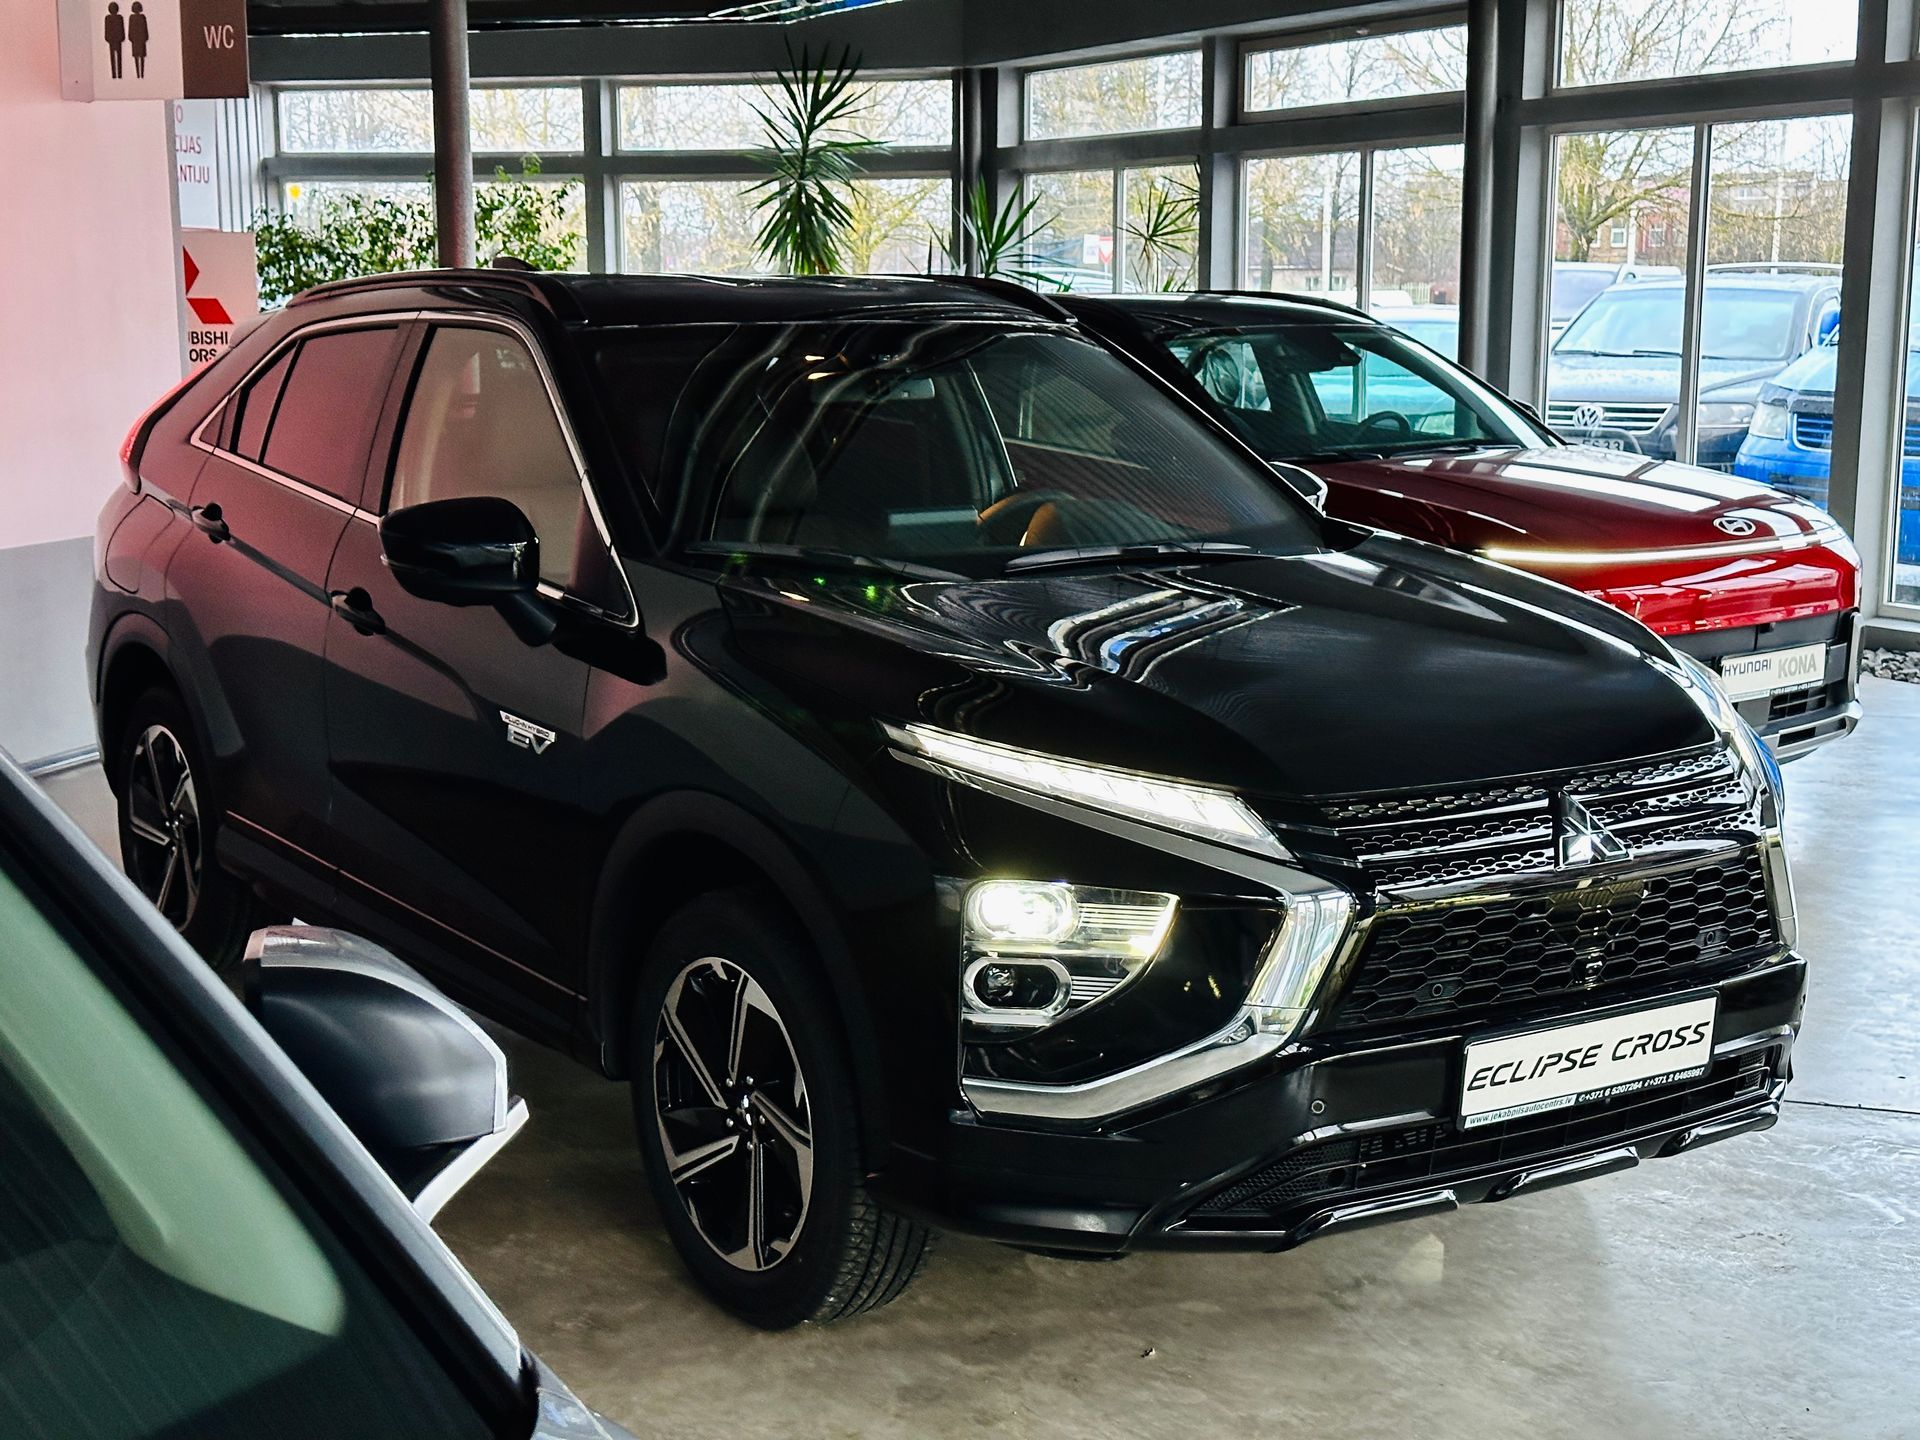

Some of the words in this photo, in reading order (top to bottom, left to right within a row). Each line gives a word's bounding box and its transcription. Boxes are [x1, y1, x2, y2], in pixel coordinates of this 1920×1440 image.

[203, 24, 234, 49] WC
[178, 164, 210, 184] NTIJU
[188, 330, 228, 345] BISHI
[1723, 657, 1772, 677] HYUNDAI
[1777, 653, 1817, 679] KONA
[1466, 1043, 1604, 1092] ECLIPSE
[1611, 1020, 1711, 1062] CROSS
